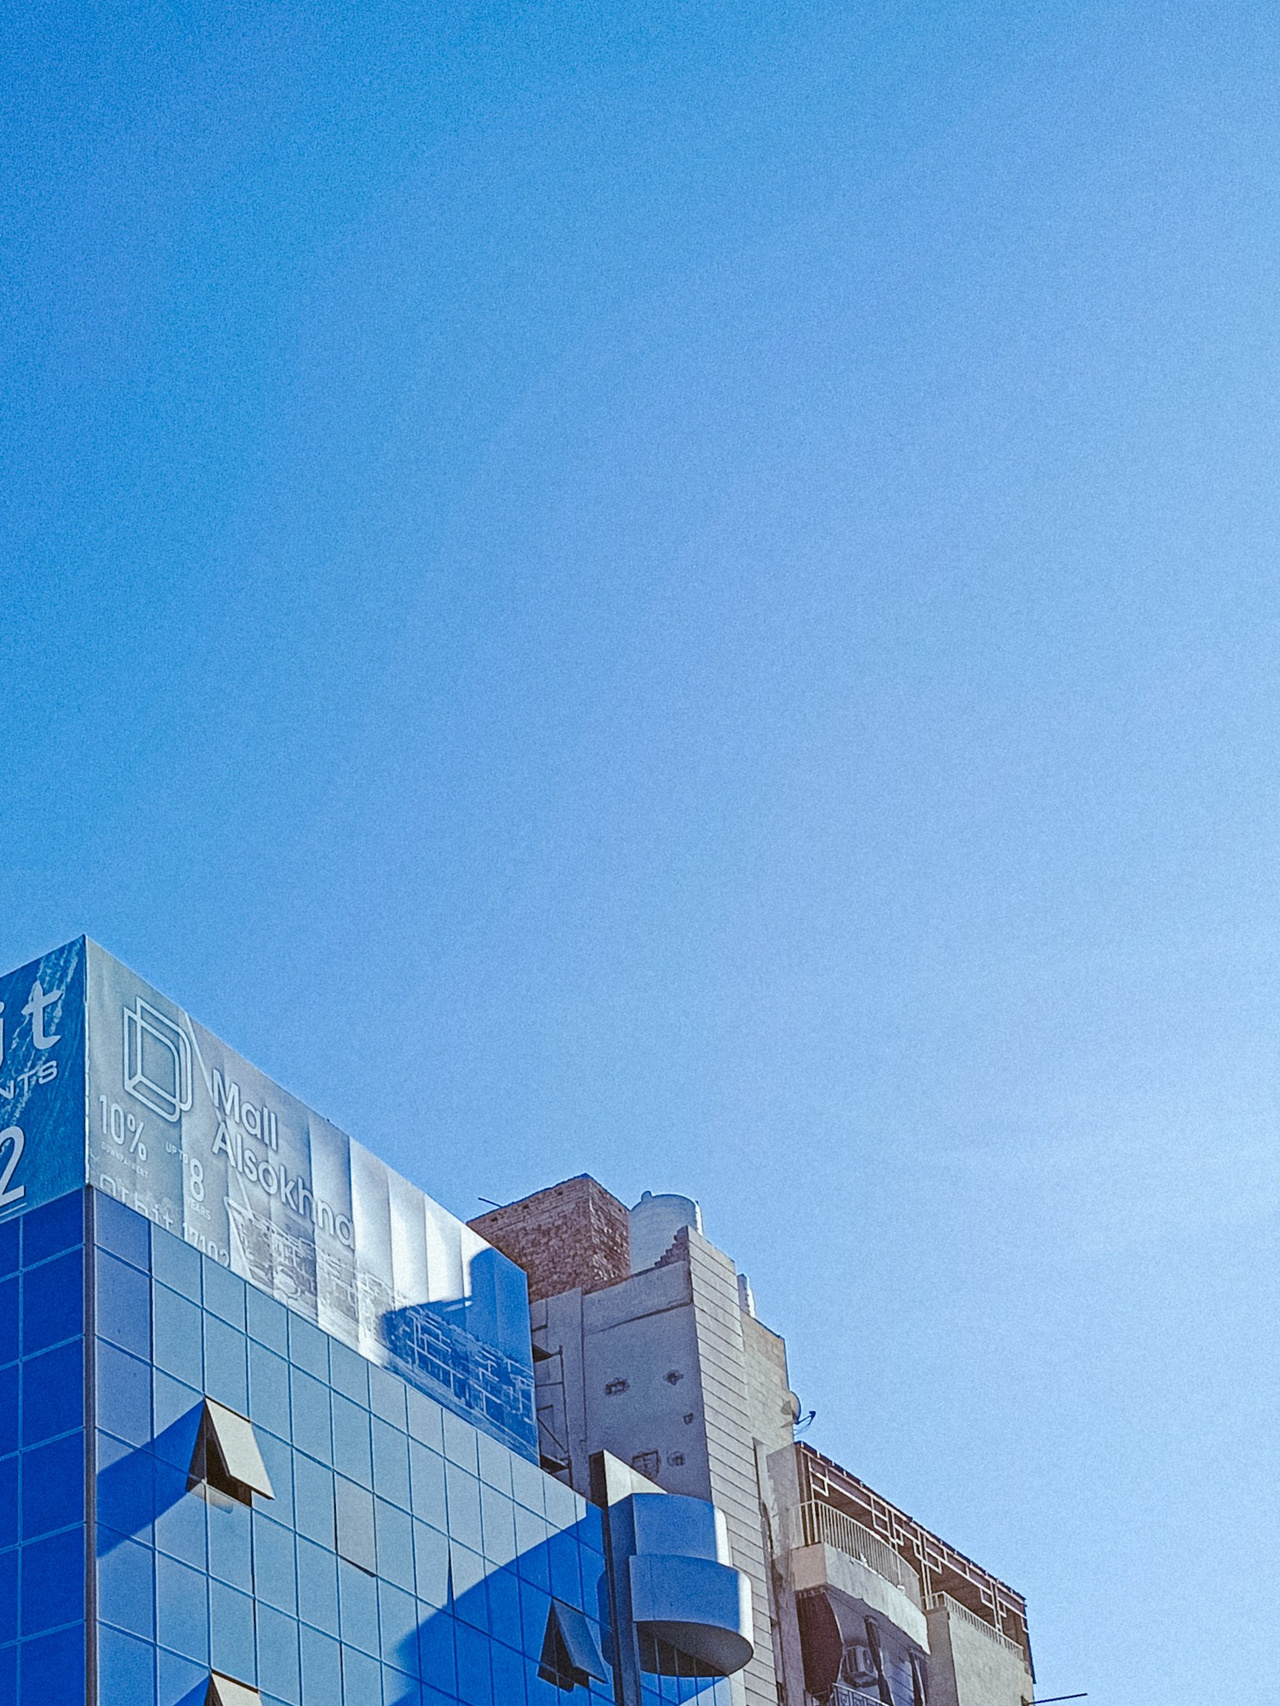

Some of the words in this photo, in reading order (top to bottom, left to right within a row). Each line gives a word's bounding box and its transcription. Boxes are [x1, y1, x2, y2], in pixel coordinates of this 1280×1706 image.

[99, 1094, 148, 1162] 10%
[211, 1067, 278, 1151] Mall
[165, 1141, 178, 1155] UP
[186, 1196, 212, 1221] YEARS
[189, 1158, 205, 1203] 8
[212, 1120, 356, 1250] Alsokhna
